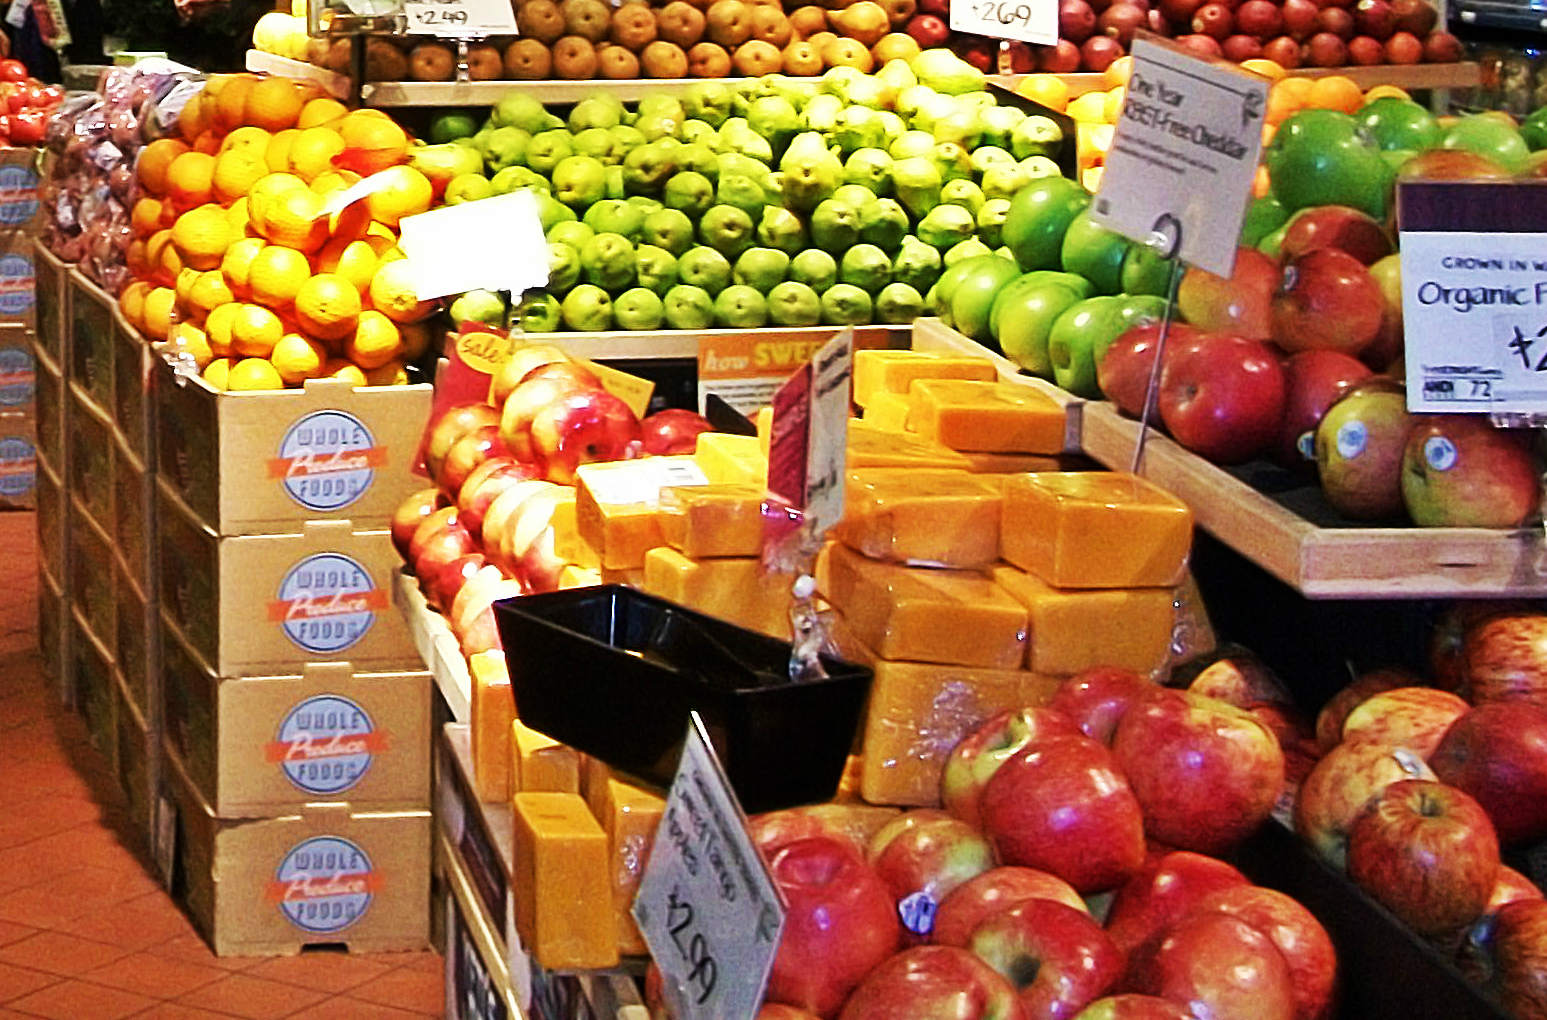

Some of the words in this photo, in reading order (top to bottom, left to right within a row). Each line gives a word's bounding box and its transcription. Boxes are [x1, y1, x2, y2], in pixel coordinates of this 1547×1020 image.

[1510, 260, 1527, 271] IN
[1417, 280, 1531, 313] Organic
[1534, 282, 1547, 305] F
[704, 349, 749, 372] how
[298, 426, 361, 446] WHOLE
[297, 570, 360, 589] WHOLE
[296, 711, 361, 730] WHOLE
[294, 851, 360, 870] WHOLE
